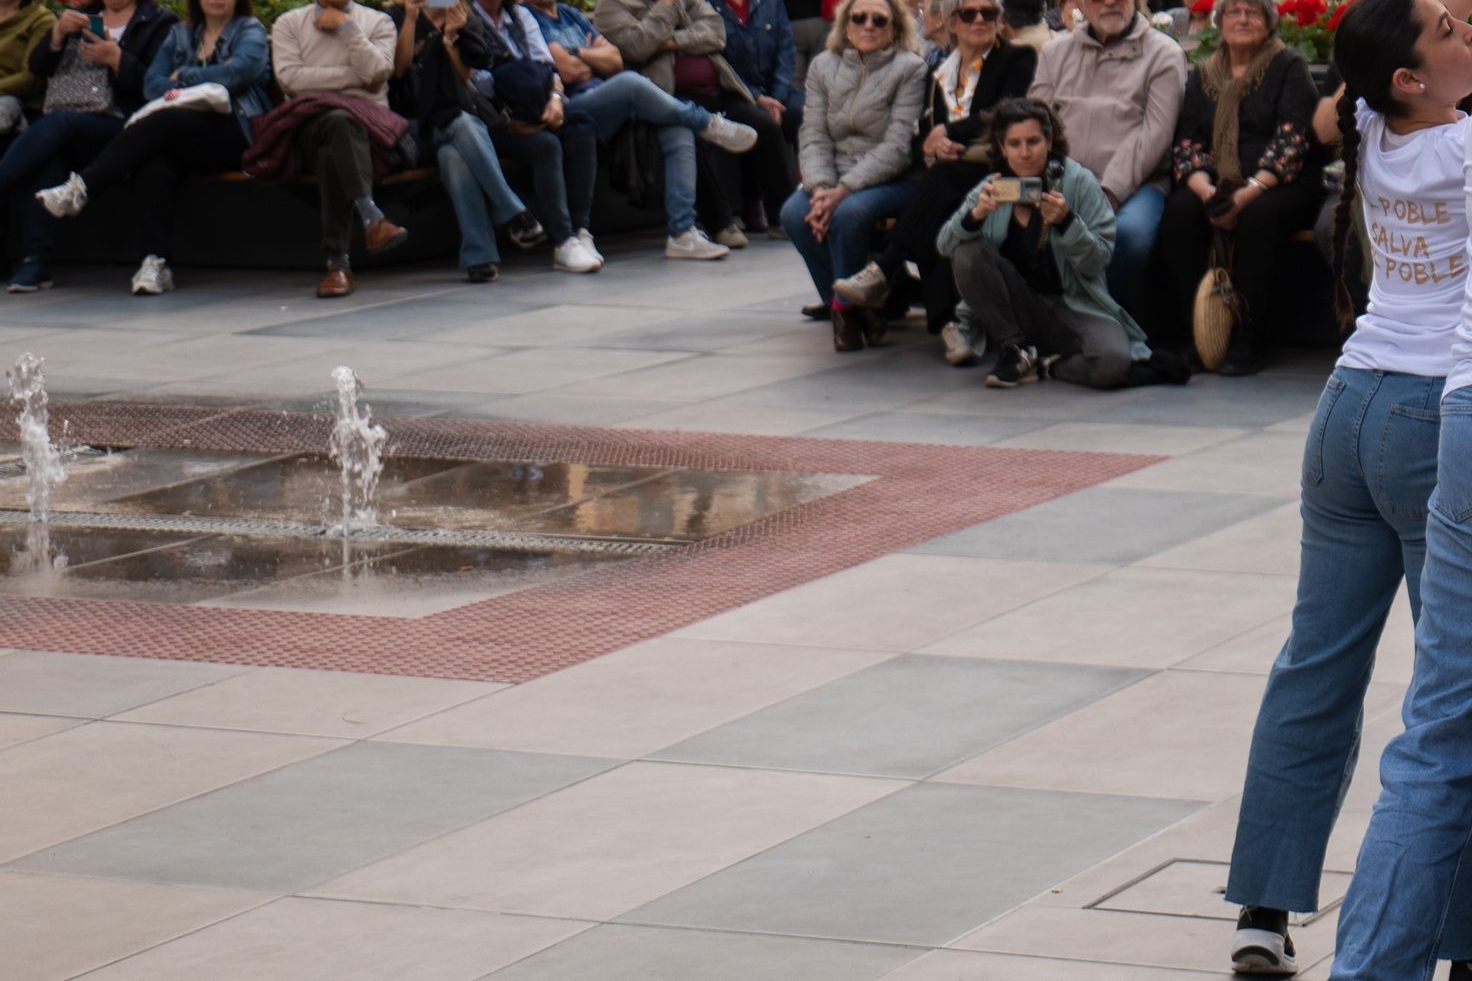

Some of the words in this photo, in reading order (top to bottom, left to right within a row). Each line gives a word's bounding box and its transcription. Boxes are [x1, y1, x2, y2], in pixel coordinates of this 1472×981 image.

[1378, 196, 1451, 225] POBLE
[1371, 221, 1430, 259] SALVA
[1386, 255, 1463, 284] POBLE
